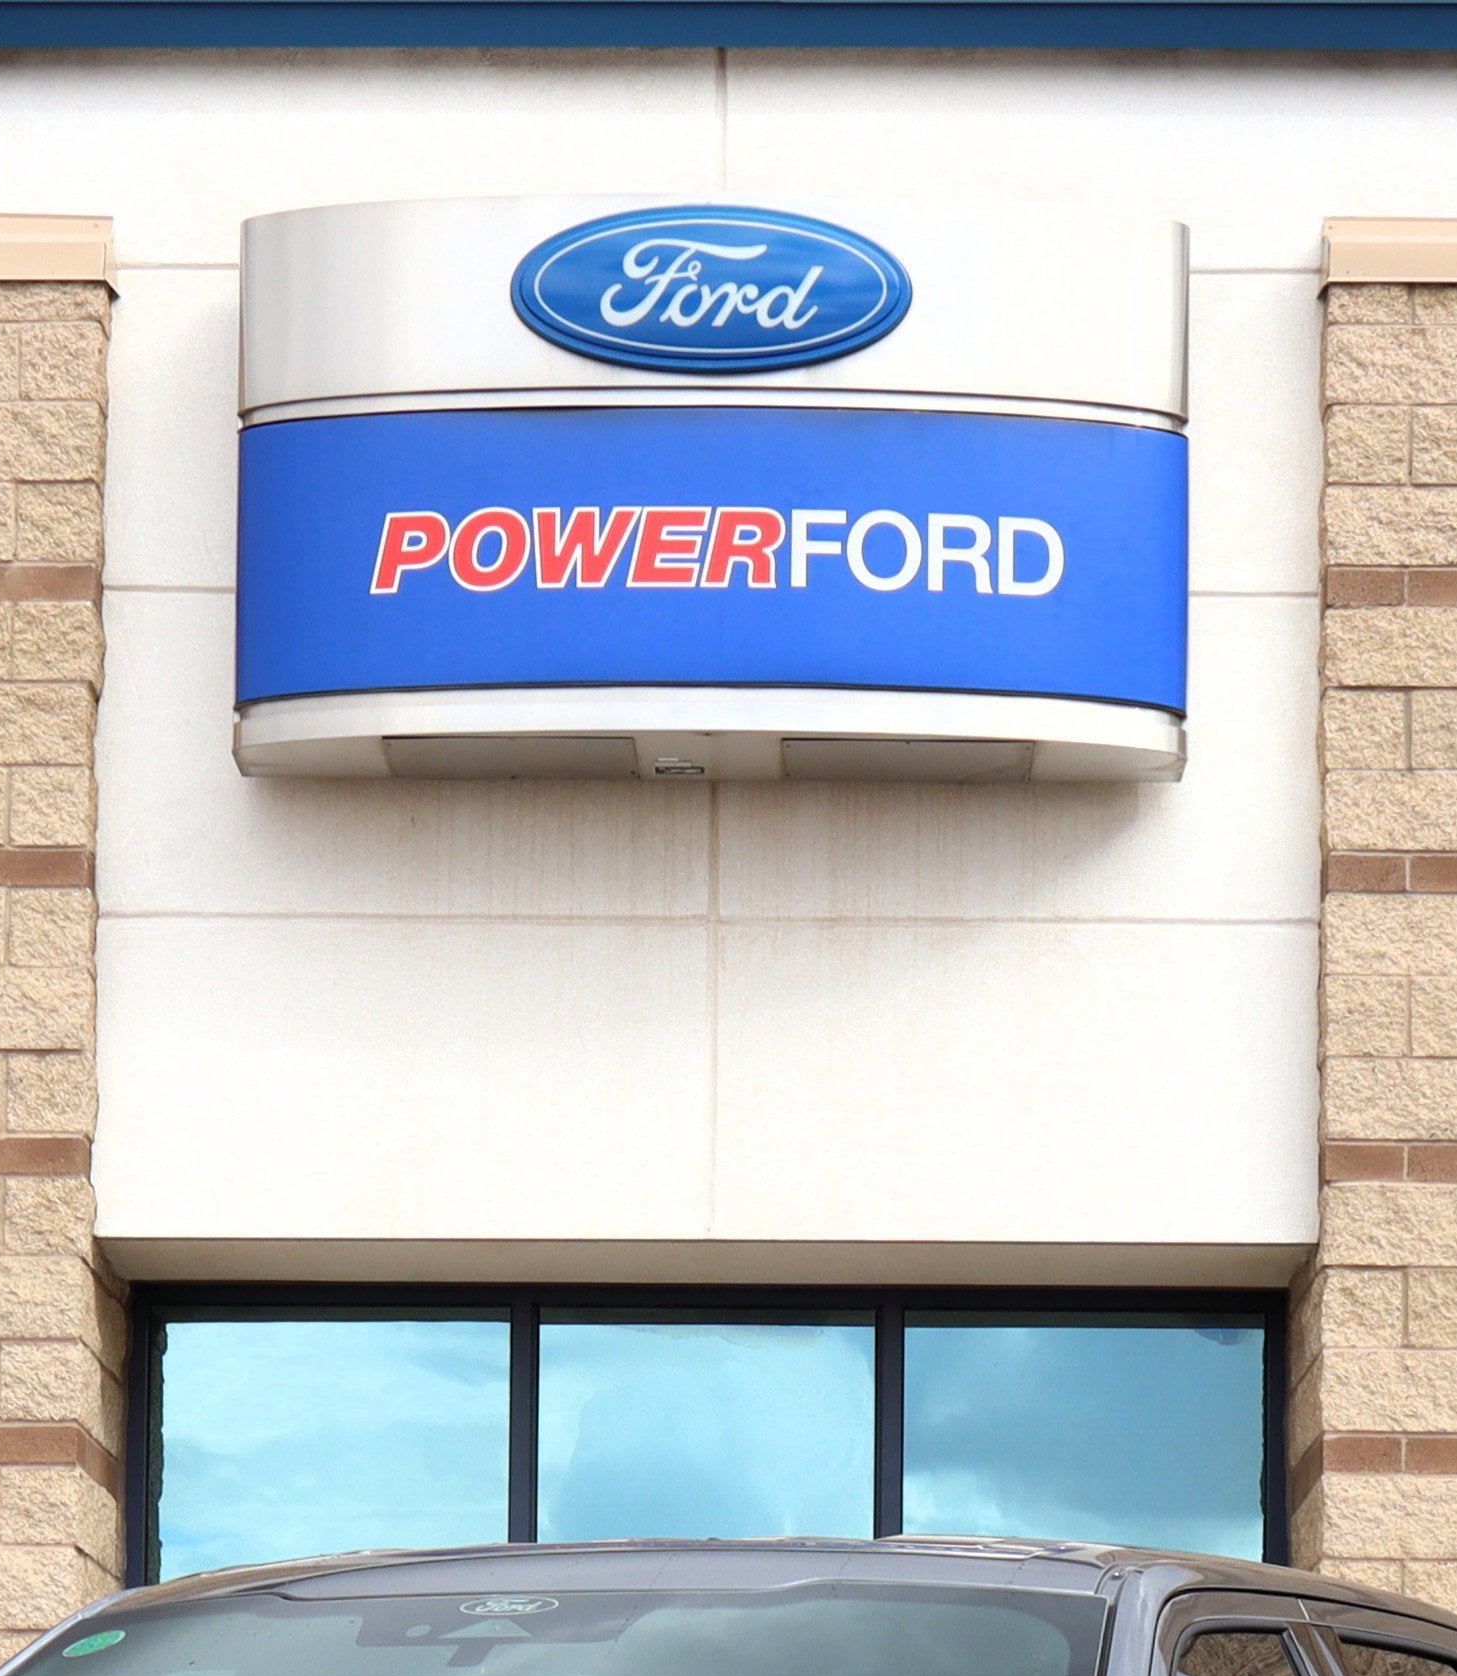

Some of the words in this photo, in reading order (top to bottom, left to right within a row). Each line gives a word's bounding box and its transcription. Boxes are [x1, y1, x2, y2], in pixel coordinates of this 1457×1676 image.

[599, 237, 823, 330] Ford
[369, 505, 1064, 597] POWERFORD
[476, 1597, 541, 1612] Ford
